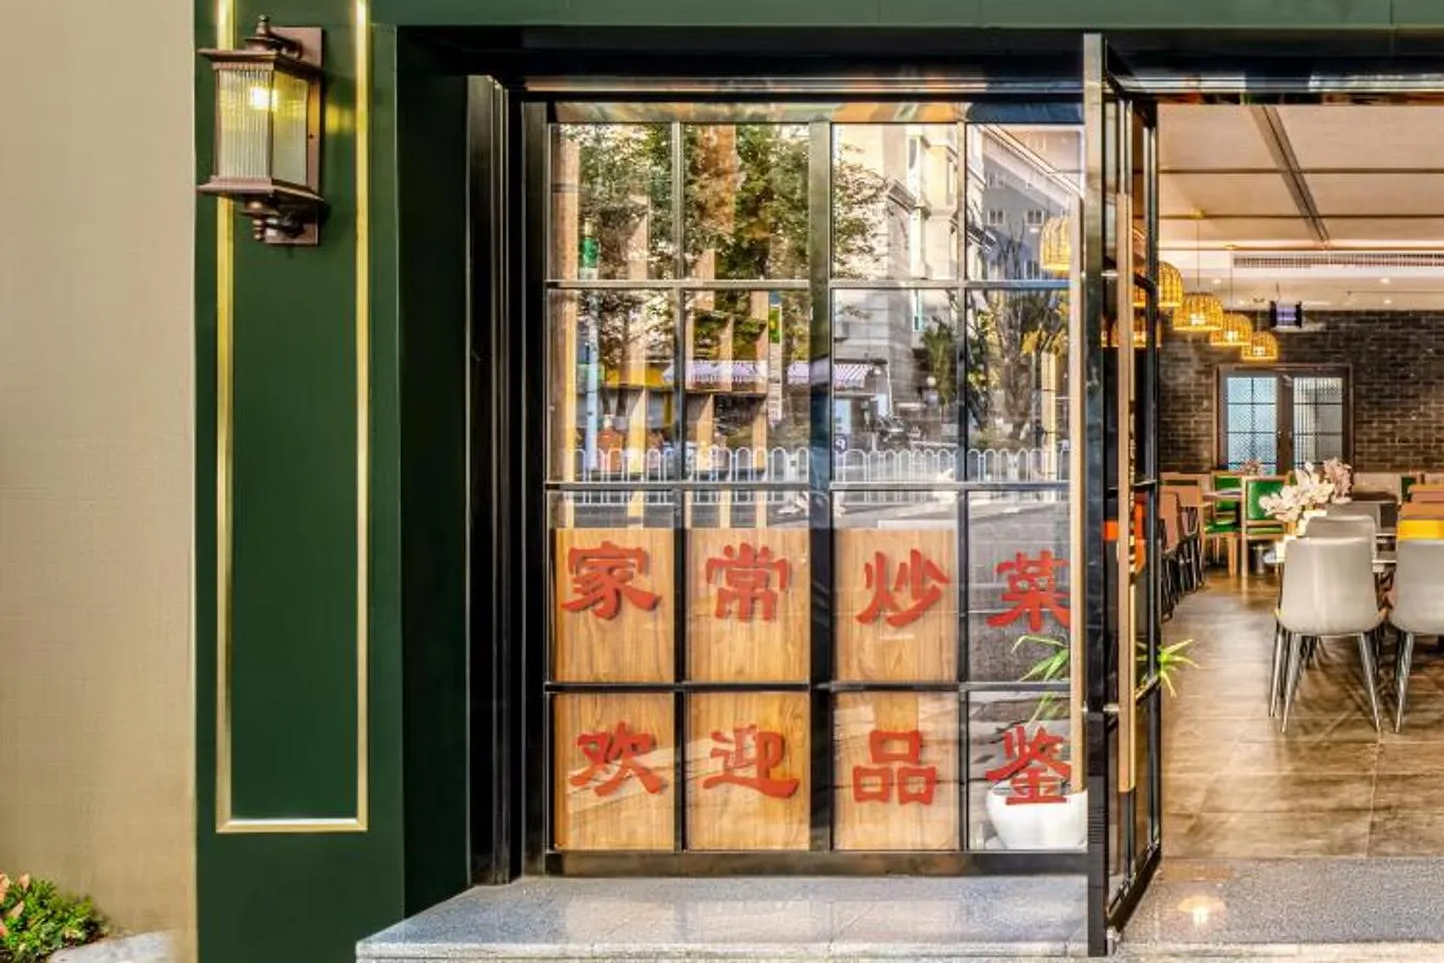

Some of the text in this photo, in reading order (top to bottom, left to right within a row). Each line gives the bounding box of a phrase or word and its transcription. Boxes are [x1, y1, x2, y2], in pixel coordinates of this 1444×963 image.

[560, 540, 1070, 632] 家常炒菜
[569, 721, 1071, 806] 欢迎品鉴
